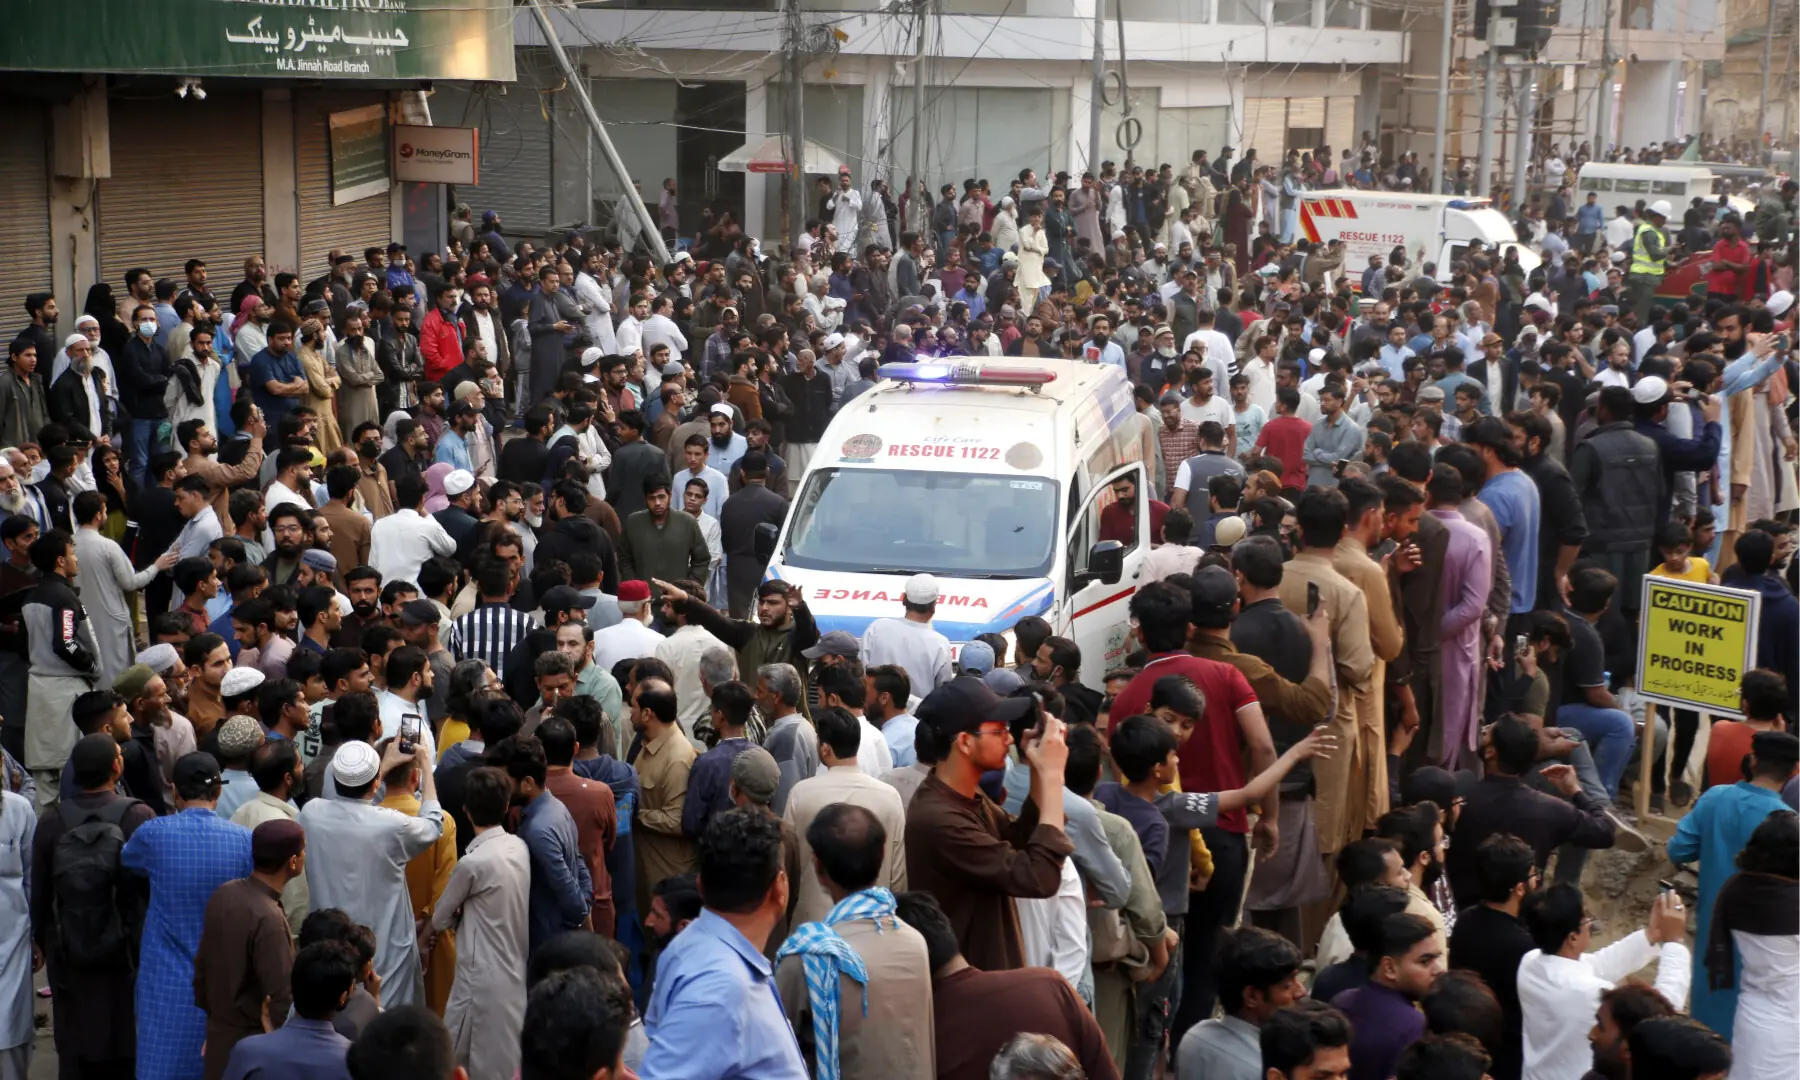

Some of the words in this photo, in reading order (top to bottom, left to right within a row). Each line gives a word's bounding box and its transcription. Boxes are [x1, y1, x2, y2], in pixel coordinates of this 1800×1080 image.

[225, 15, 280, 53] بینک
[277, 58, 296, 70] M.A.
[298, 57, 323, 72] Jinnah
[323, 60, 343, 72] Road
[344, 60, 370, 73] Branch
[1339, 231, 1378, 242] RESCUE
[1381, 234, 1405, 244] 1122
[888, 444, 955, 458] RESCUE
[960, 446, 1001, 460] 1122
[1655, 592, 1743, 621] CAUTION
[1668, 618, 1725, 641] WORK
[1684, 640, 1704, 656] IN
[1651, 653, 1737, 682] PROGRESS
